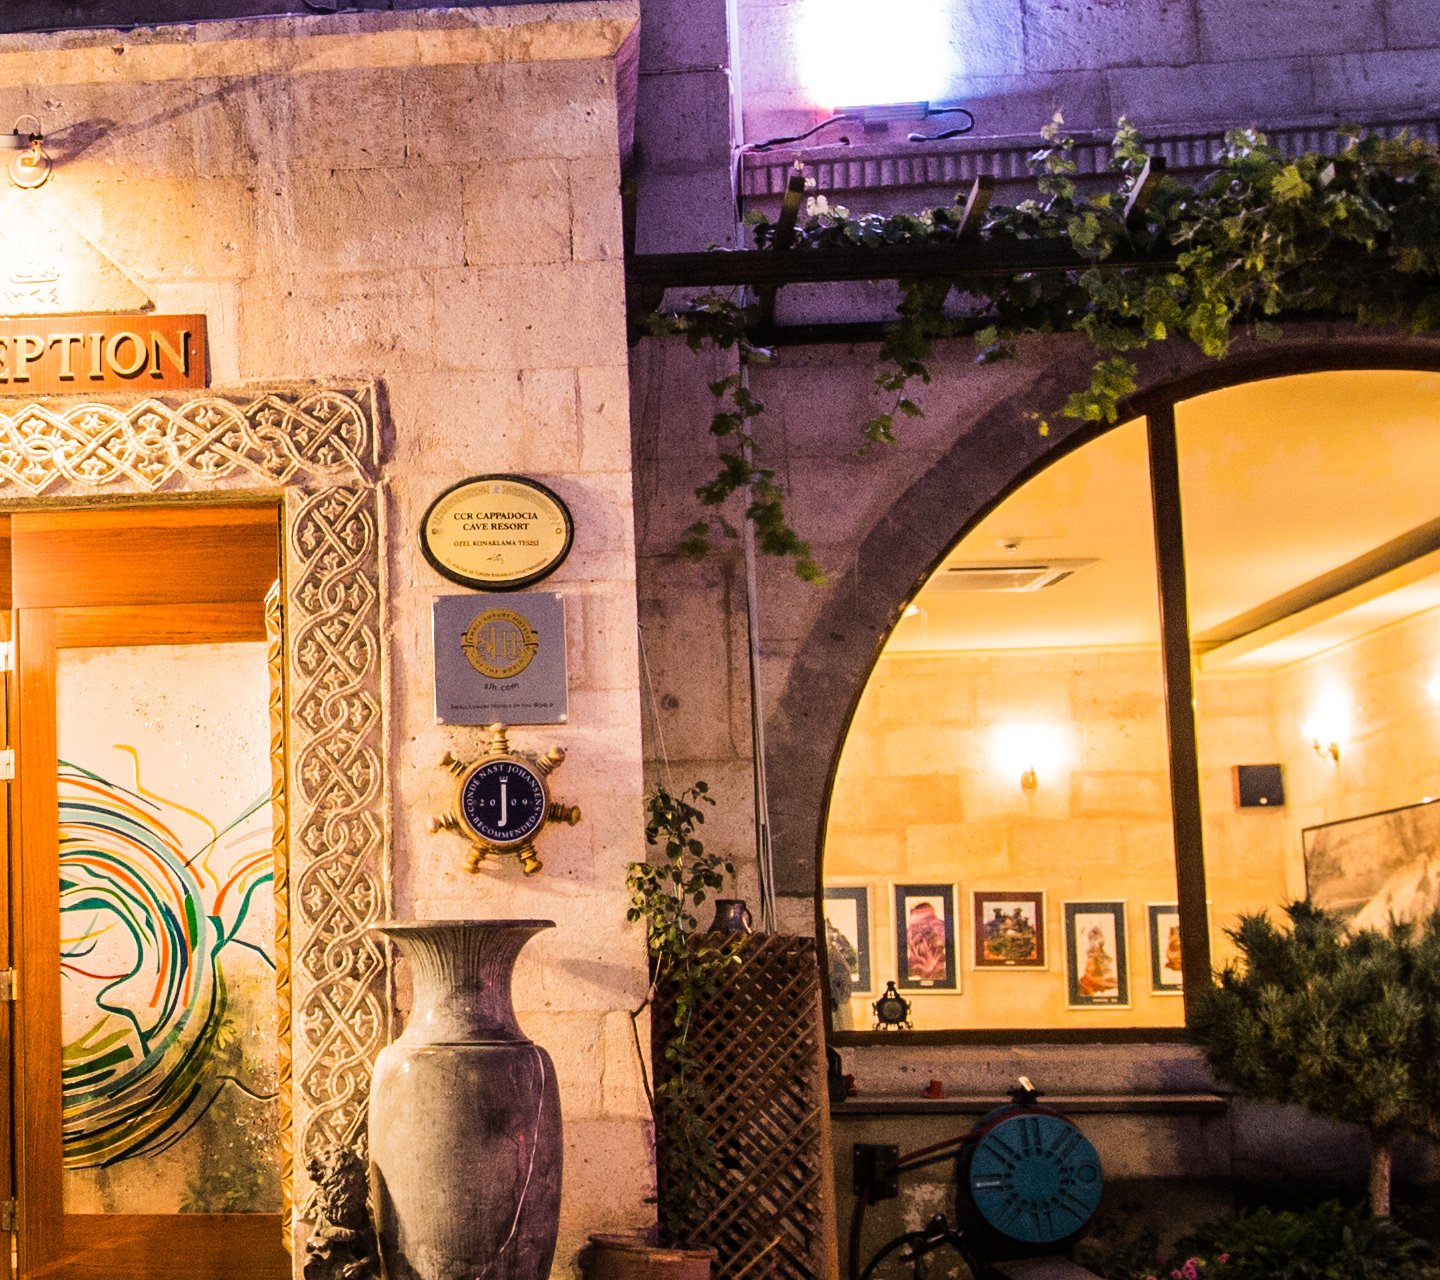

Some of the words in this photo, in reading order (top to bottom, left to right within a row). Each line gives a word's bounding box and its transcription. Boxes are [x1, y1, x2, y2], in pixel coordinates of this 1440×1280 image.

[453, 512, 474, 520] CCR
[476, 512, 539, 520] CAPPADOCIA
[462, 523, 489, 531] CAVE
[479, 764, 505, 779] NAST
[507, 764, 542, 812] JOHANSENS
[472, 815, 536, 838] RECOMMENDED
